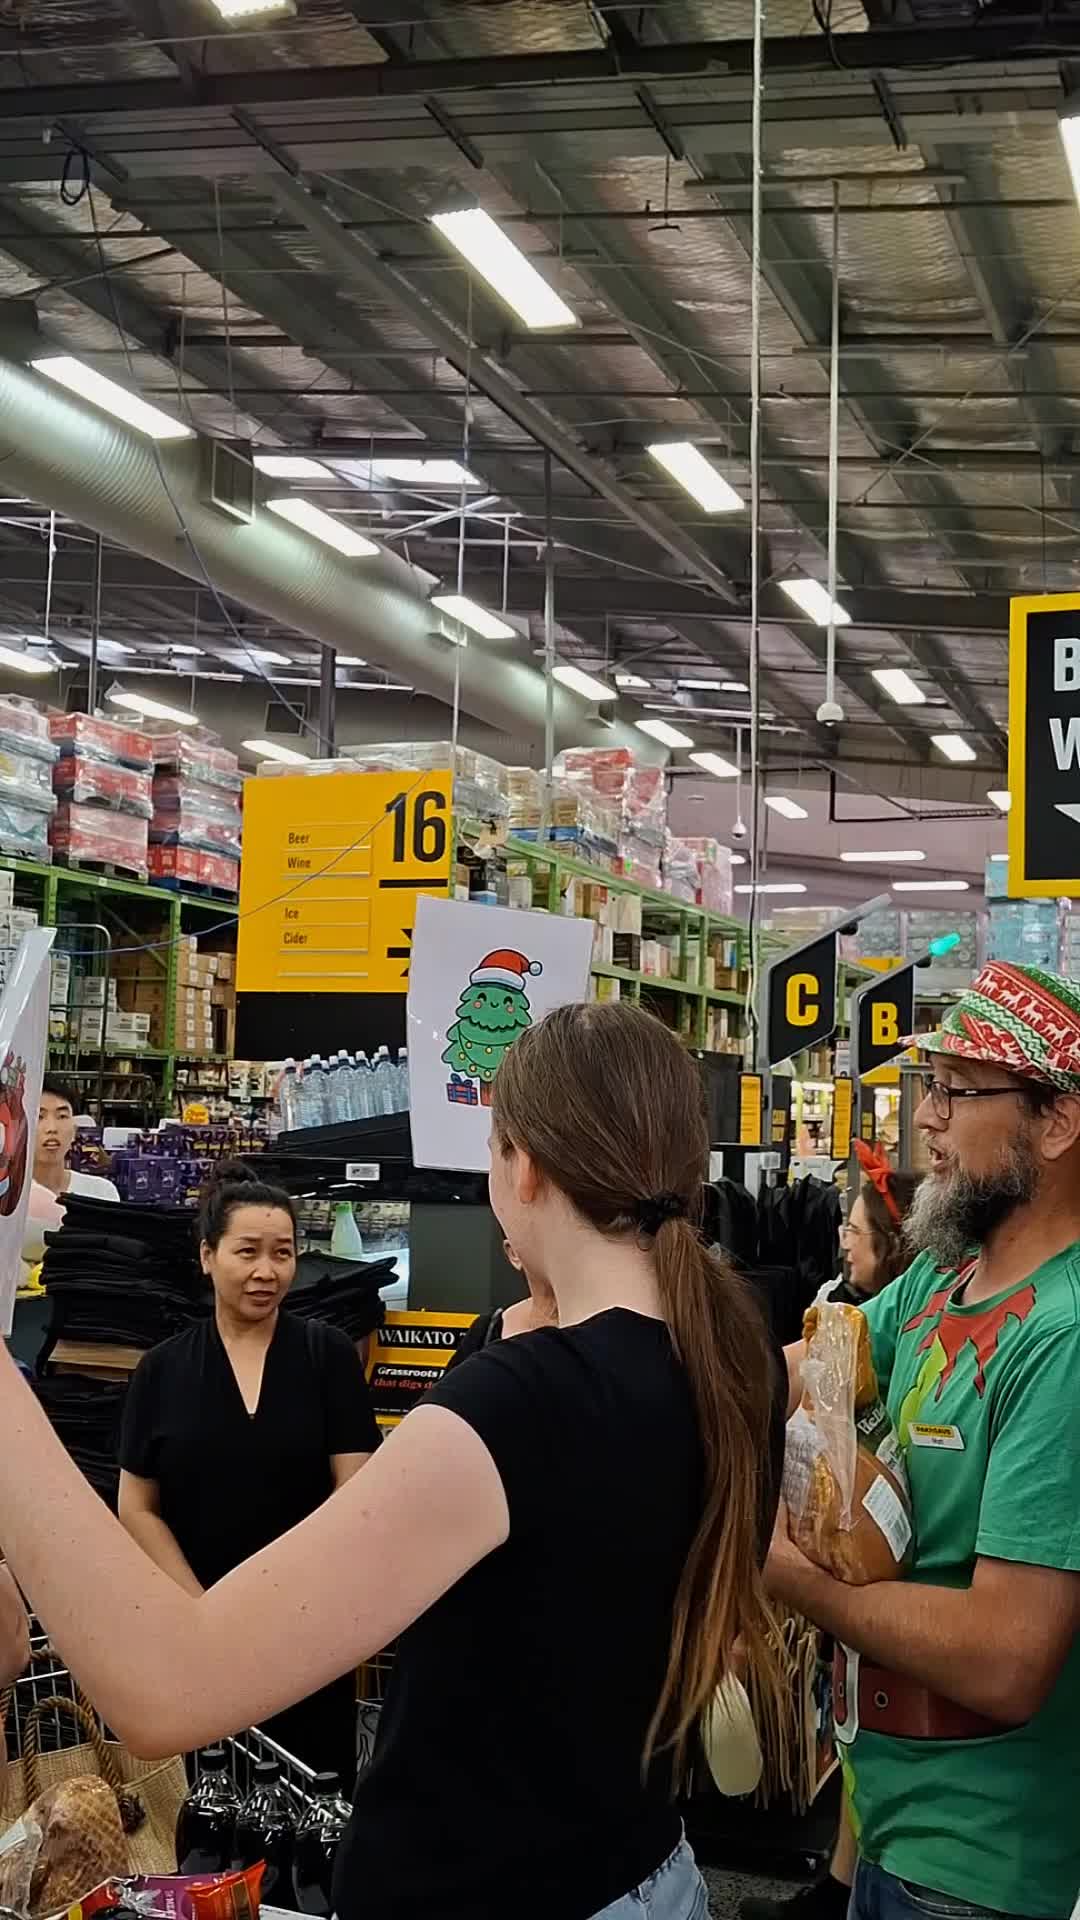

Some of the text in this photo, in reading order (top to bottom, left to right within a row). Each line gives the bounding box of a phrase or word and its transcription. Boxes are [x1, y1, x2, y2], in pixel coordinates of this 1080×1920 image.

[385, 790, 446, 863] 16
[288, 832, 310, 844] Beer
[287, 857, 311, 868] Wine
[284, 908, 299, 919] Ice
[283, 932, 308, 944] Cider
[786, 973, 819, 1026] C
[871, 1002, 898, 1045] B
[379, 1329, 455, 1345] WAIKATO
[377, 1367, 438, 1378] Grassroots
[424, 1381, 433, 1389] d
